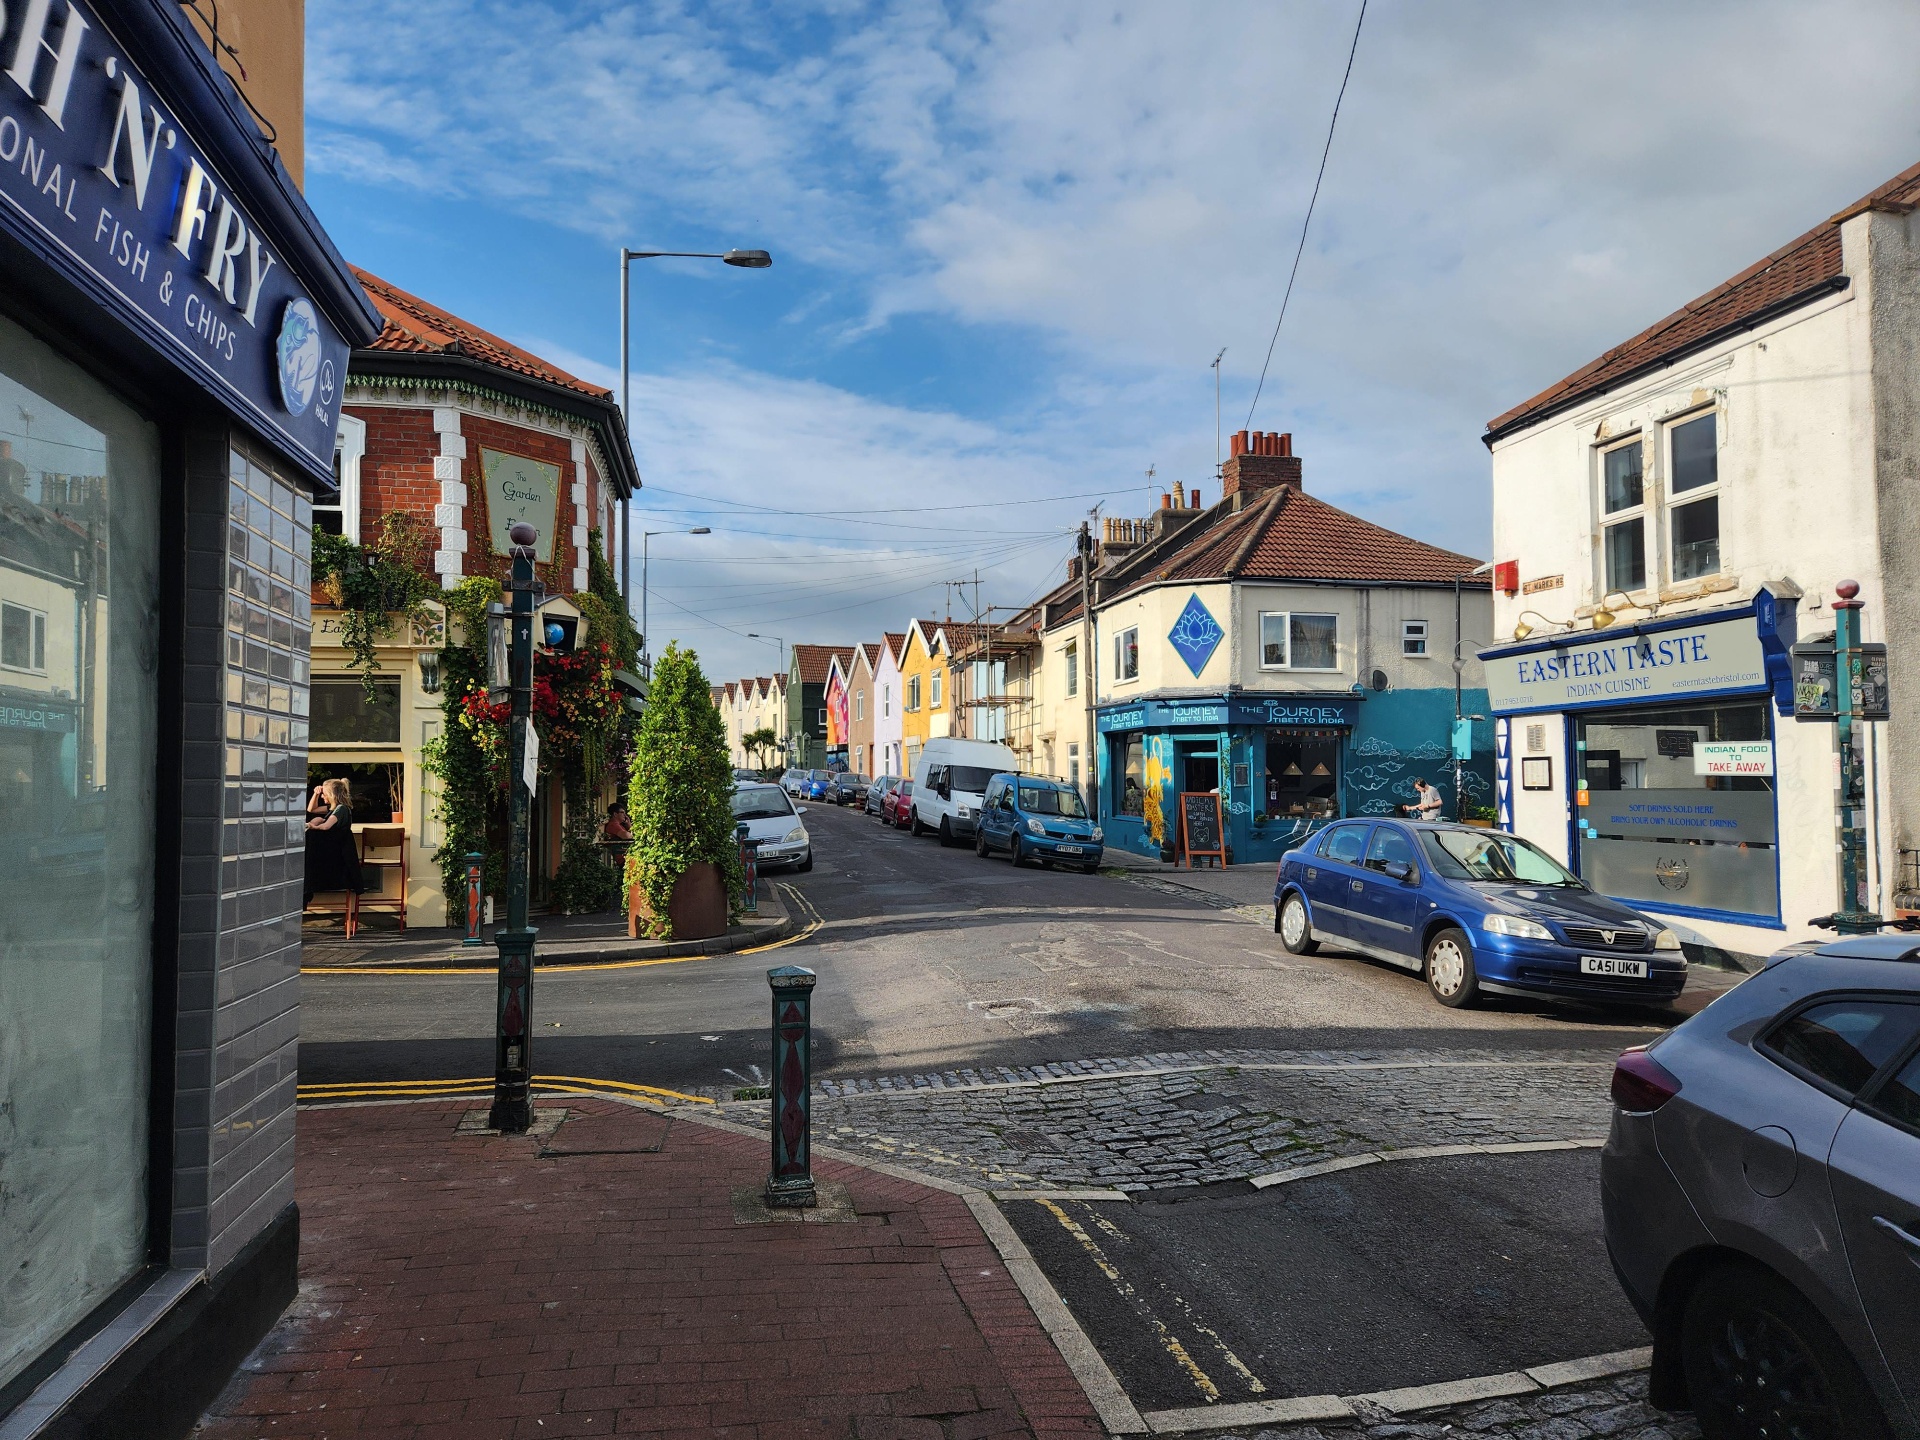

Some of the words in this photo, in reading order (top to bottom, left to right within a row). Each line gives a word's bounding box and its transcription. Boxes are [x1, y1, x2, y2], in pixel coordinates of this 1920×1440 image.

[173, 156, 276, 328] FRY
[95, 208, 149, 282] FISH
[159, 271, 173, 305] &
[185, 293, 236, 361] CHIPS
[314, 403, 329, 427] HALAL
[515, 471, 527, 481] The
[502, 481, 541, 502] Garden
[519, 506, 526, 517] of
[1518, 647, 1618, 684] EASTERN
[1622, 634, 1711, 671] TASTE
[1566, 682, 1602, 698] INDIAN
[1605, 676, 1651, 694] CUISINE
[1672, 671, 1760, 689] easterntastebristol.com
[1172, 706, 1218, 722] JOURNEY
[1267, 705, 1343, 722] JOURNEY
[1740, 745, 1768, 753] FOOD
[1707, 762, 1732, 772] TAKE
[1735, 762, 1766, 772] AWAY
[1628, 804, 1645, 812] SOFT
[1647, 805, 1672, 813] DRINKS
[1673, 805, 1693, 813] SOLD
[1694, 806, 1714, 814] HERE
[1611, 815, 1630, 824] BRING
[1631, 816, 1649, 825] YOUR
[1650, 817, 1666, 825] OWN
[1667, 817, 1708, 827] ALCOHOLIC
[1709, 819, 1738, 828] DRINKS
[1588, 959, 1615, 973] CA51
[1618, 961, 1640, 975] UKW
